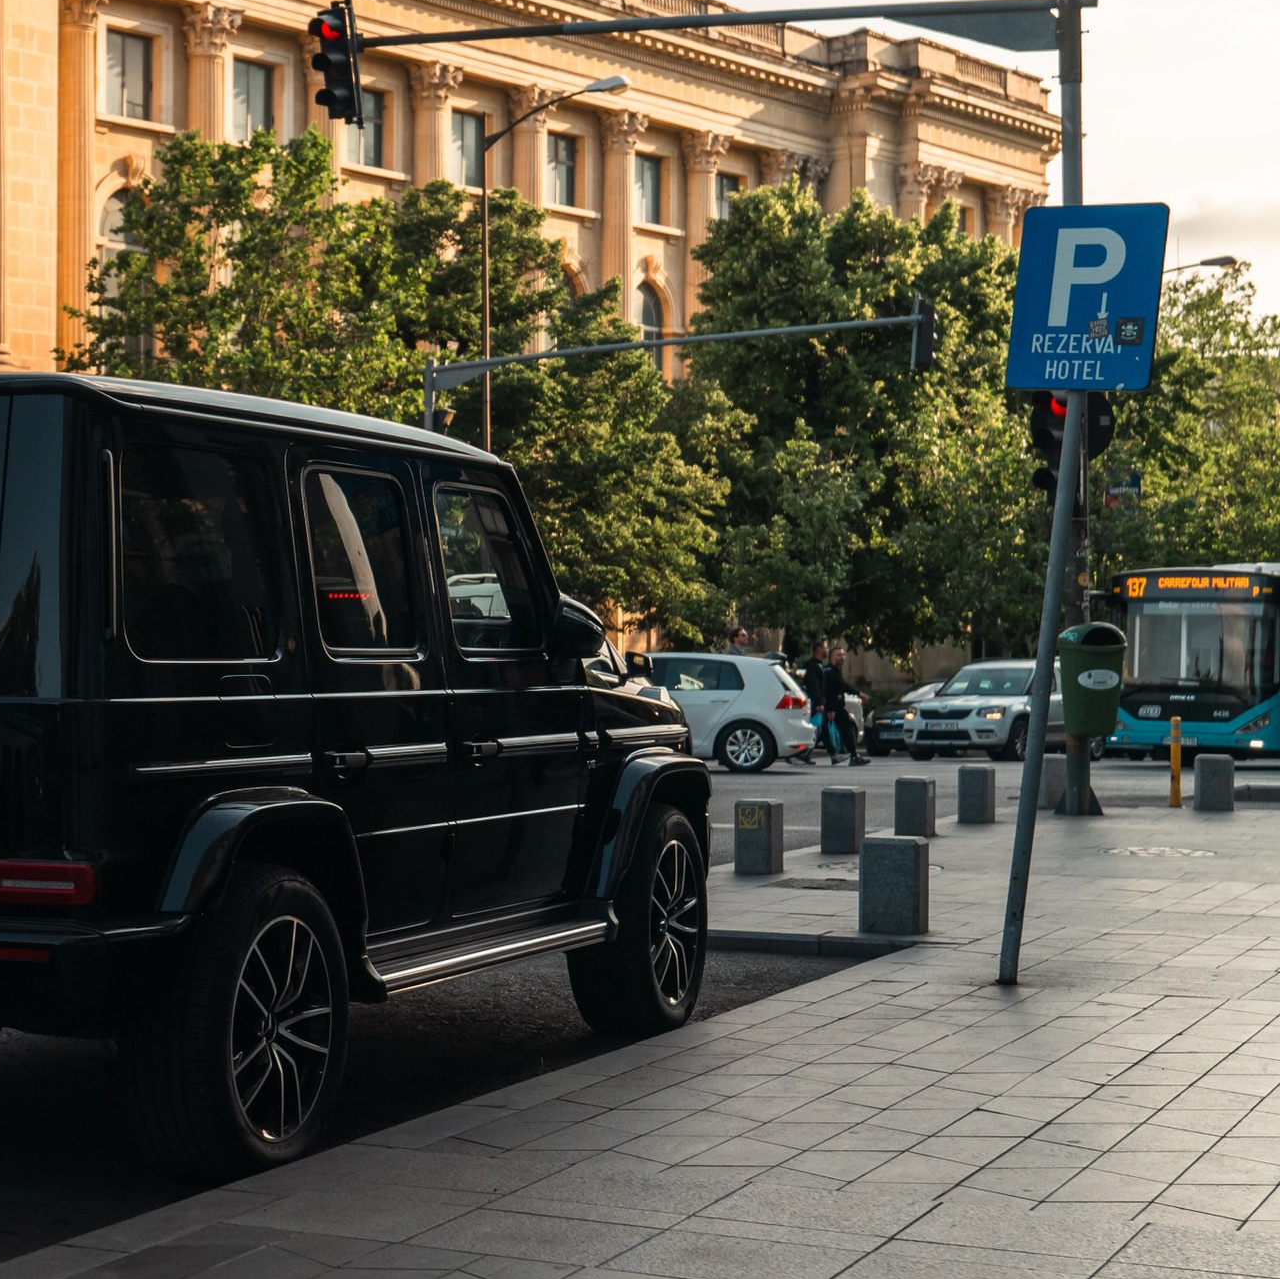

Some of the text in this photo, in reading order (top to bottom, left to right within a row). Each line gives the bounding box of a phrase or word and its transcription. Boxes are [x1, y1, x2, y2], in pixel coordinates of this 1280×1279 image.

[1047, 227, 1127, 327] P
[1044, 360, 1105, 381] HOTEL
[1126, 577, 1250, 597] 137 CARREFOUR MILITARI
